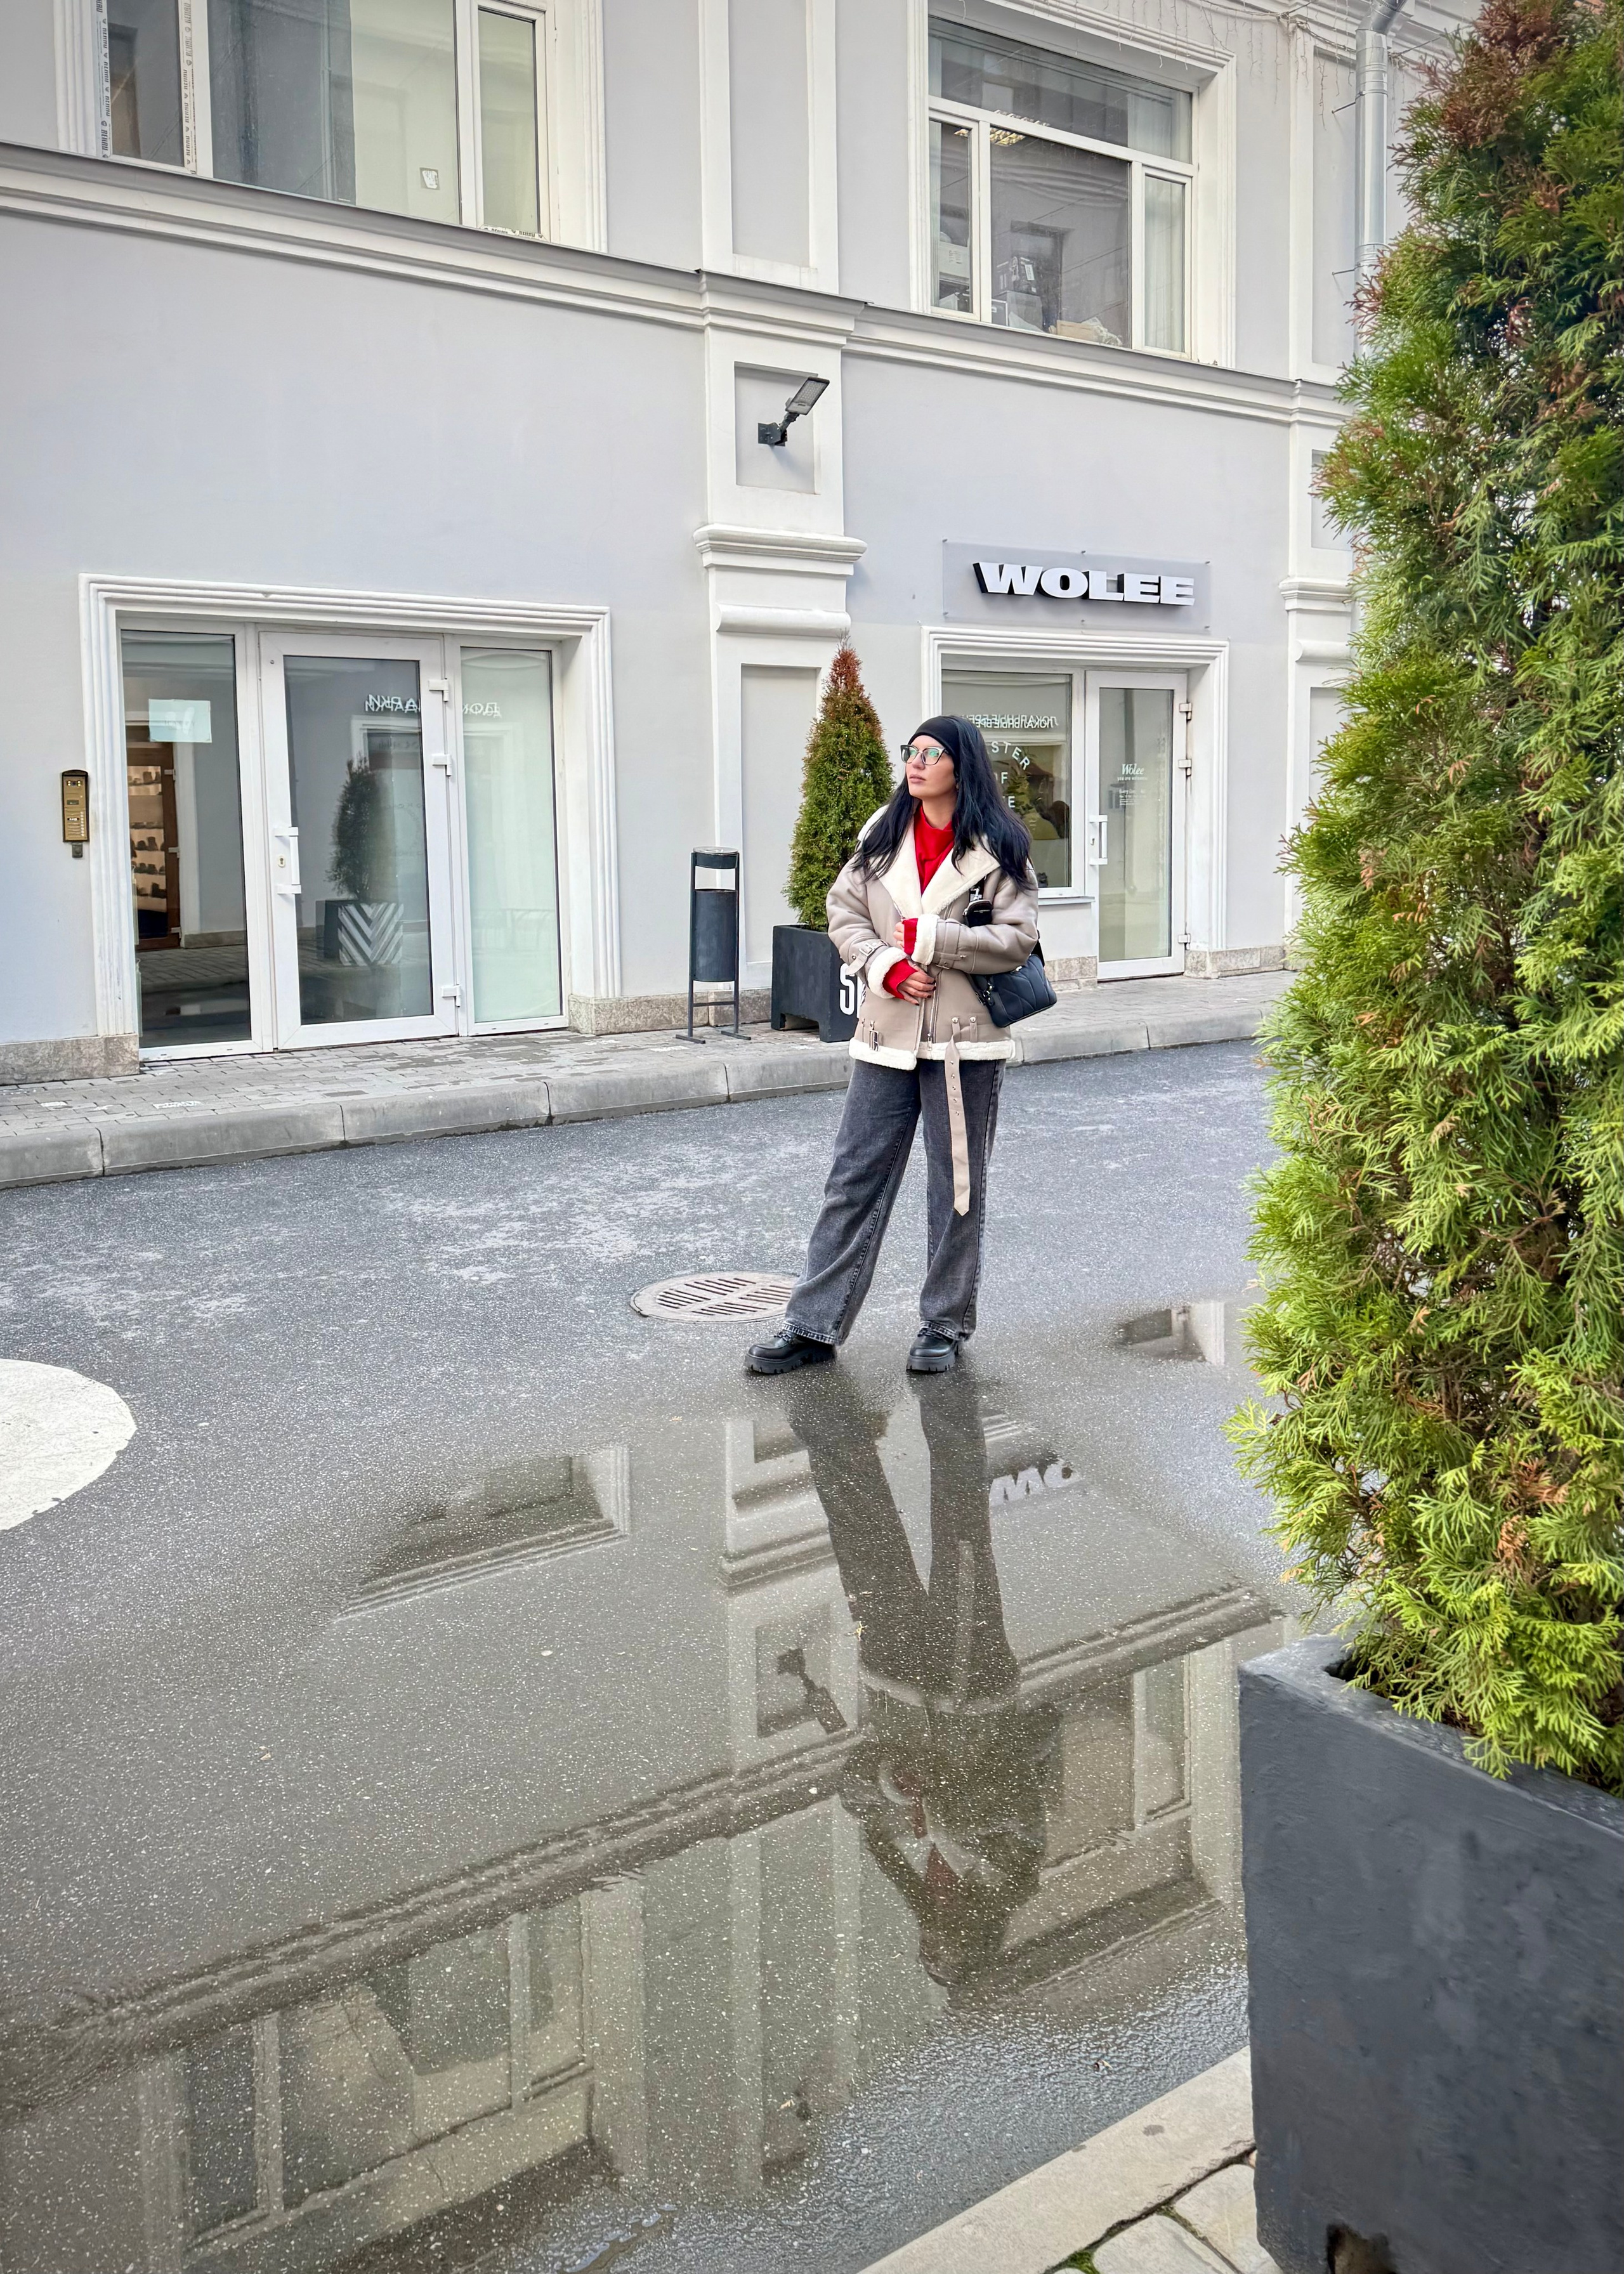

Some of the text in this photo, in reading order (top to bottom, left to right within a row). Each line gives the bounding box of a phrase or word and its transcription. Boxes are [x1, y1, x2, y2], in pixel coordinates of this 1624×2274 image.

[974, 562, 1195, 606] WOLEE
[991, 741, 1030, 770] STER
[1122, 763, 1145, 774] Wolee
